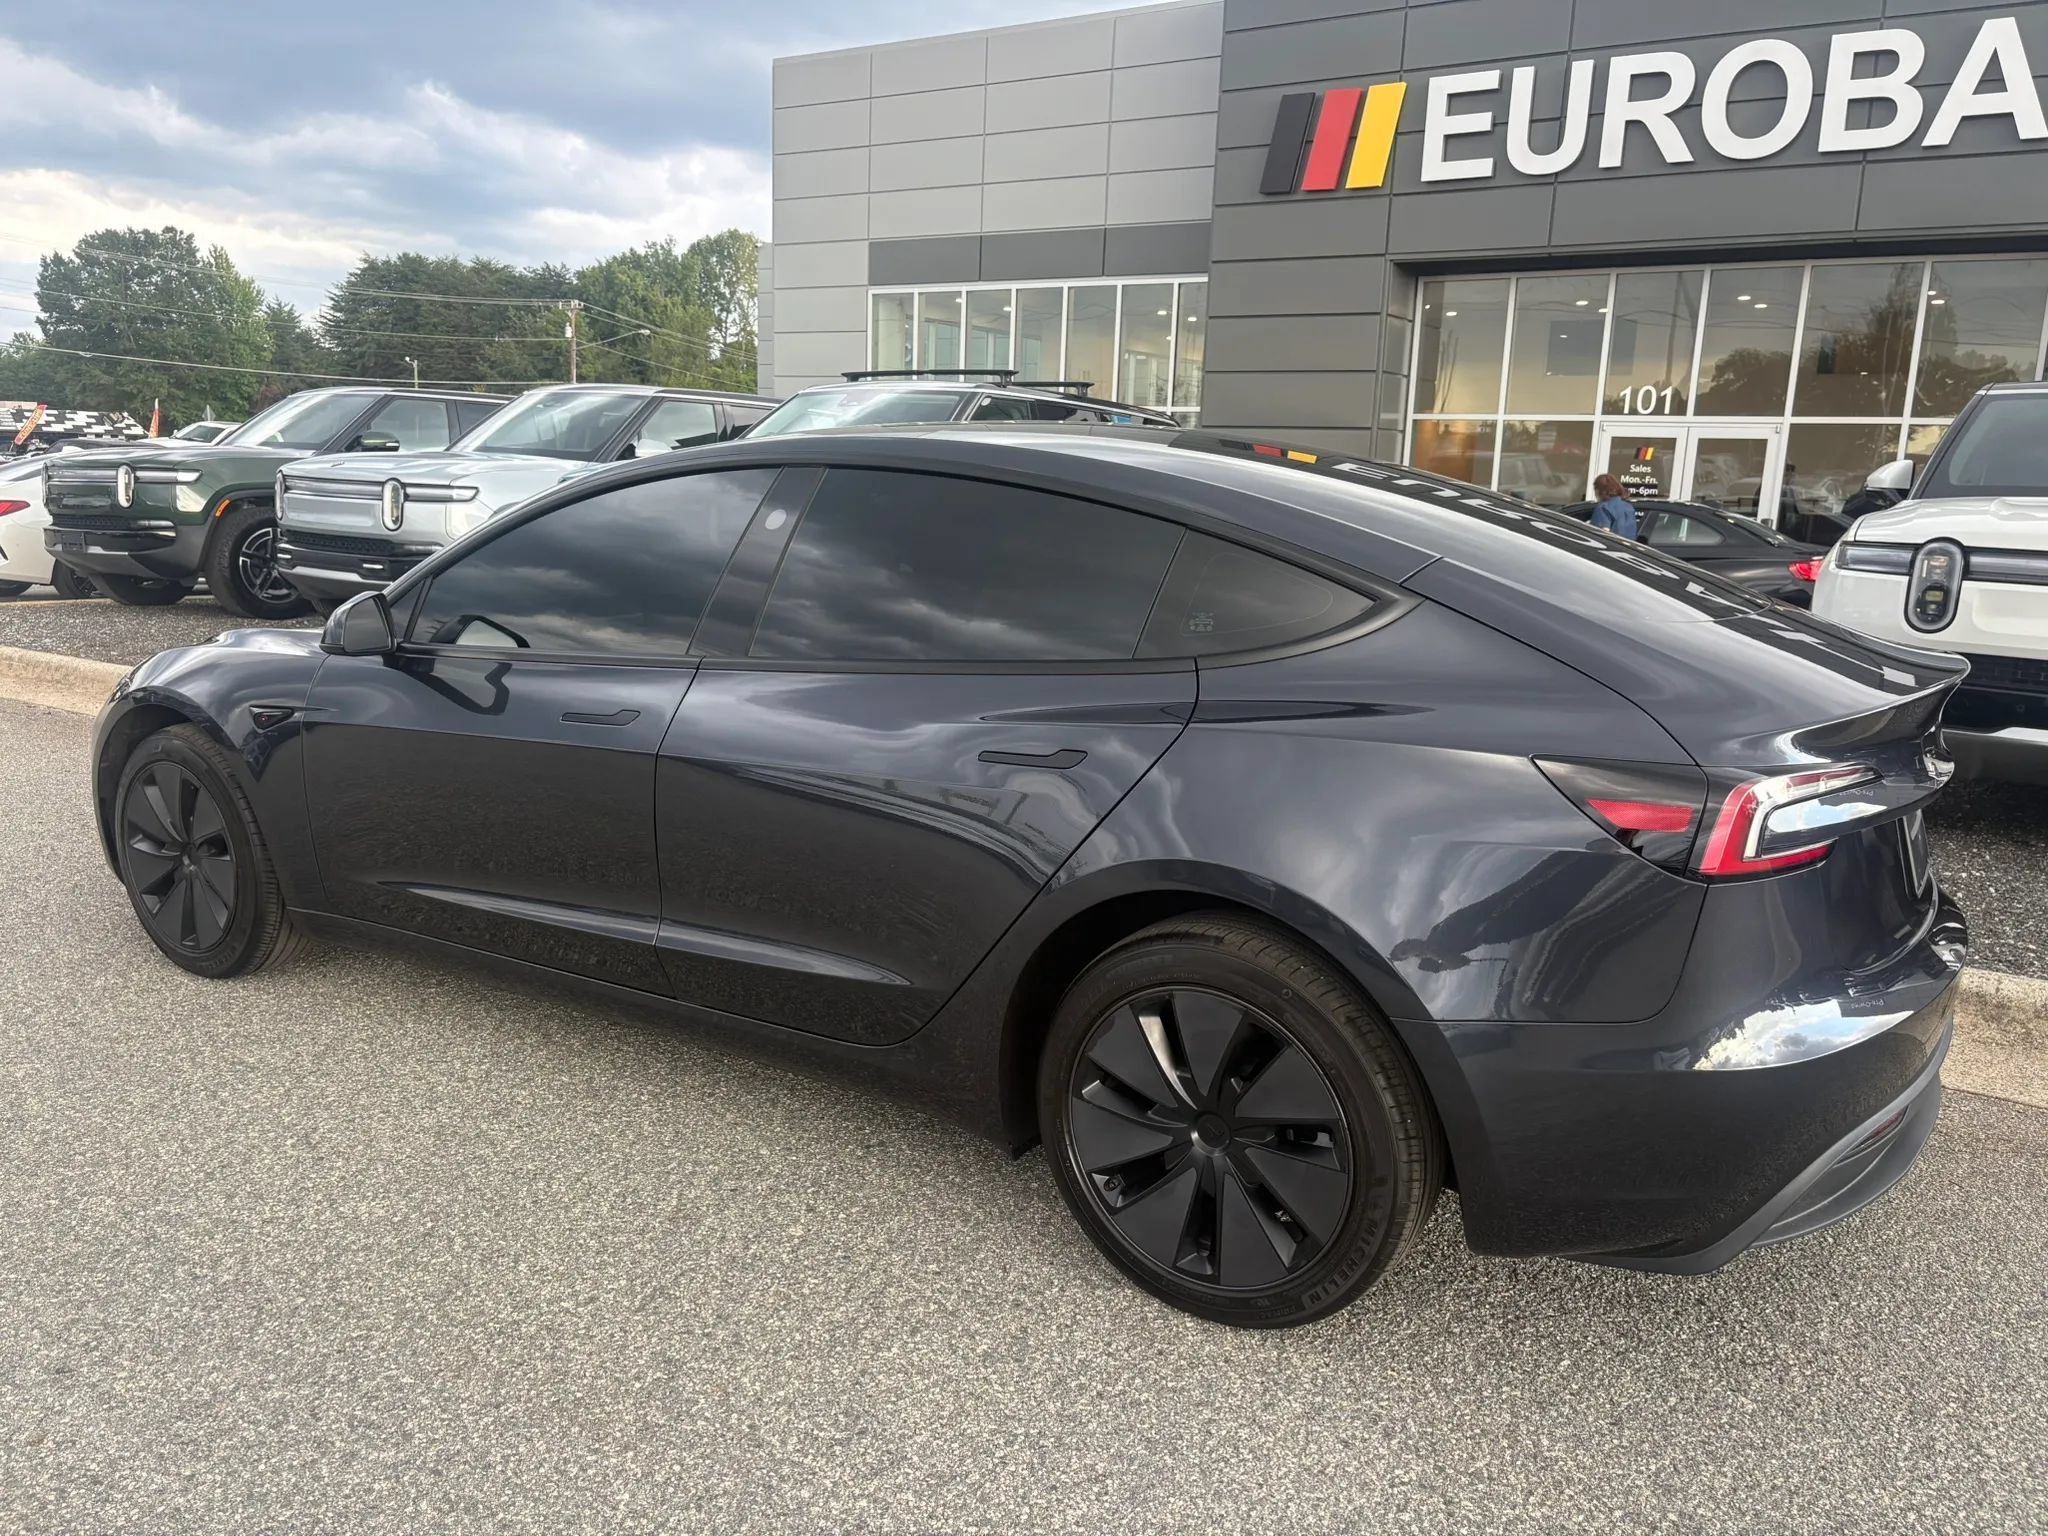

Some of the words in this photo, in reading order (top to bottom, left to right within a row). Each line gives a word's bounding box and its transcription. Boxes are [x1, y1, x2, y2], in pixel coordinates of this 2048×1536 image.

[1421, 17, 2048, 183] EUROBA
[1619, 385, 1673, 415] 101
[1629, 464, 1652, 473] Sales
[1307, 1218, 1378, 1305] MICHELIN
